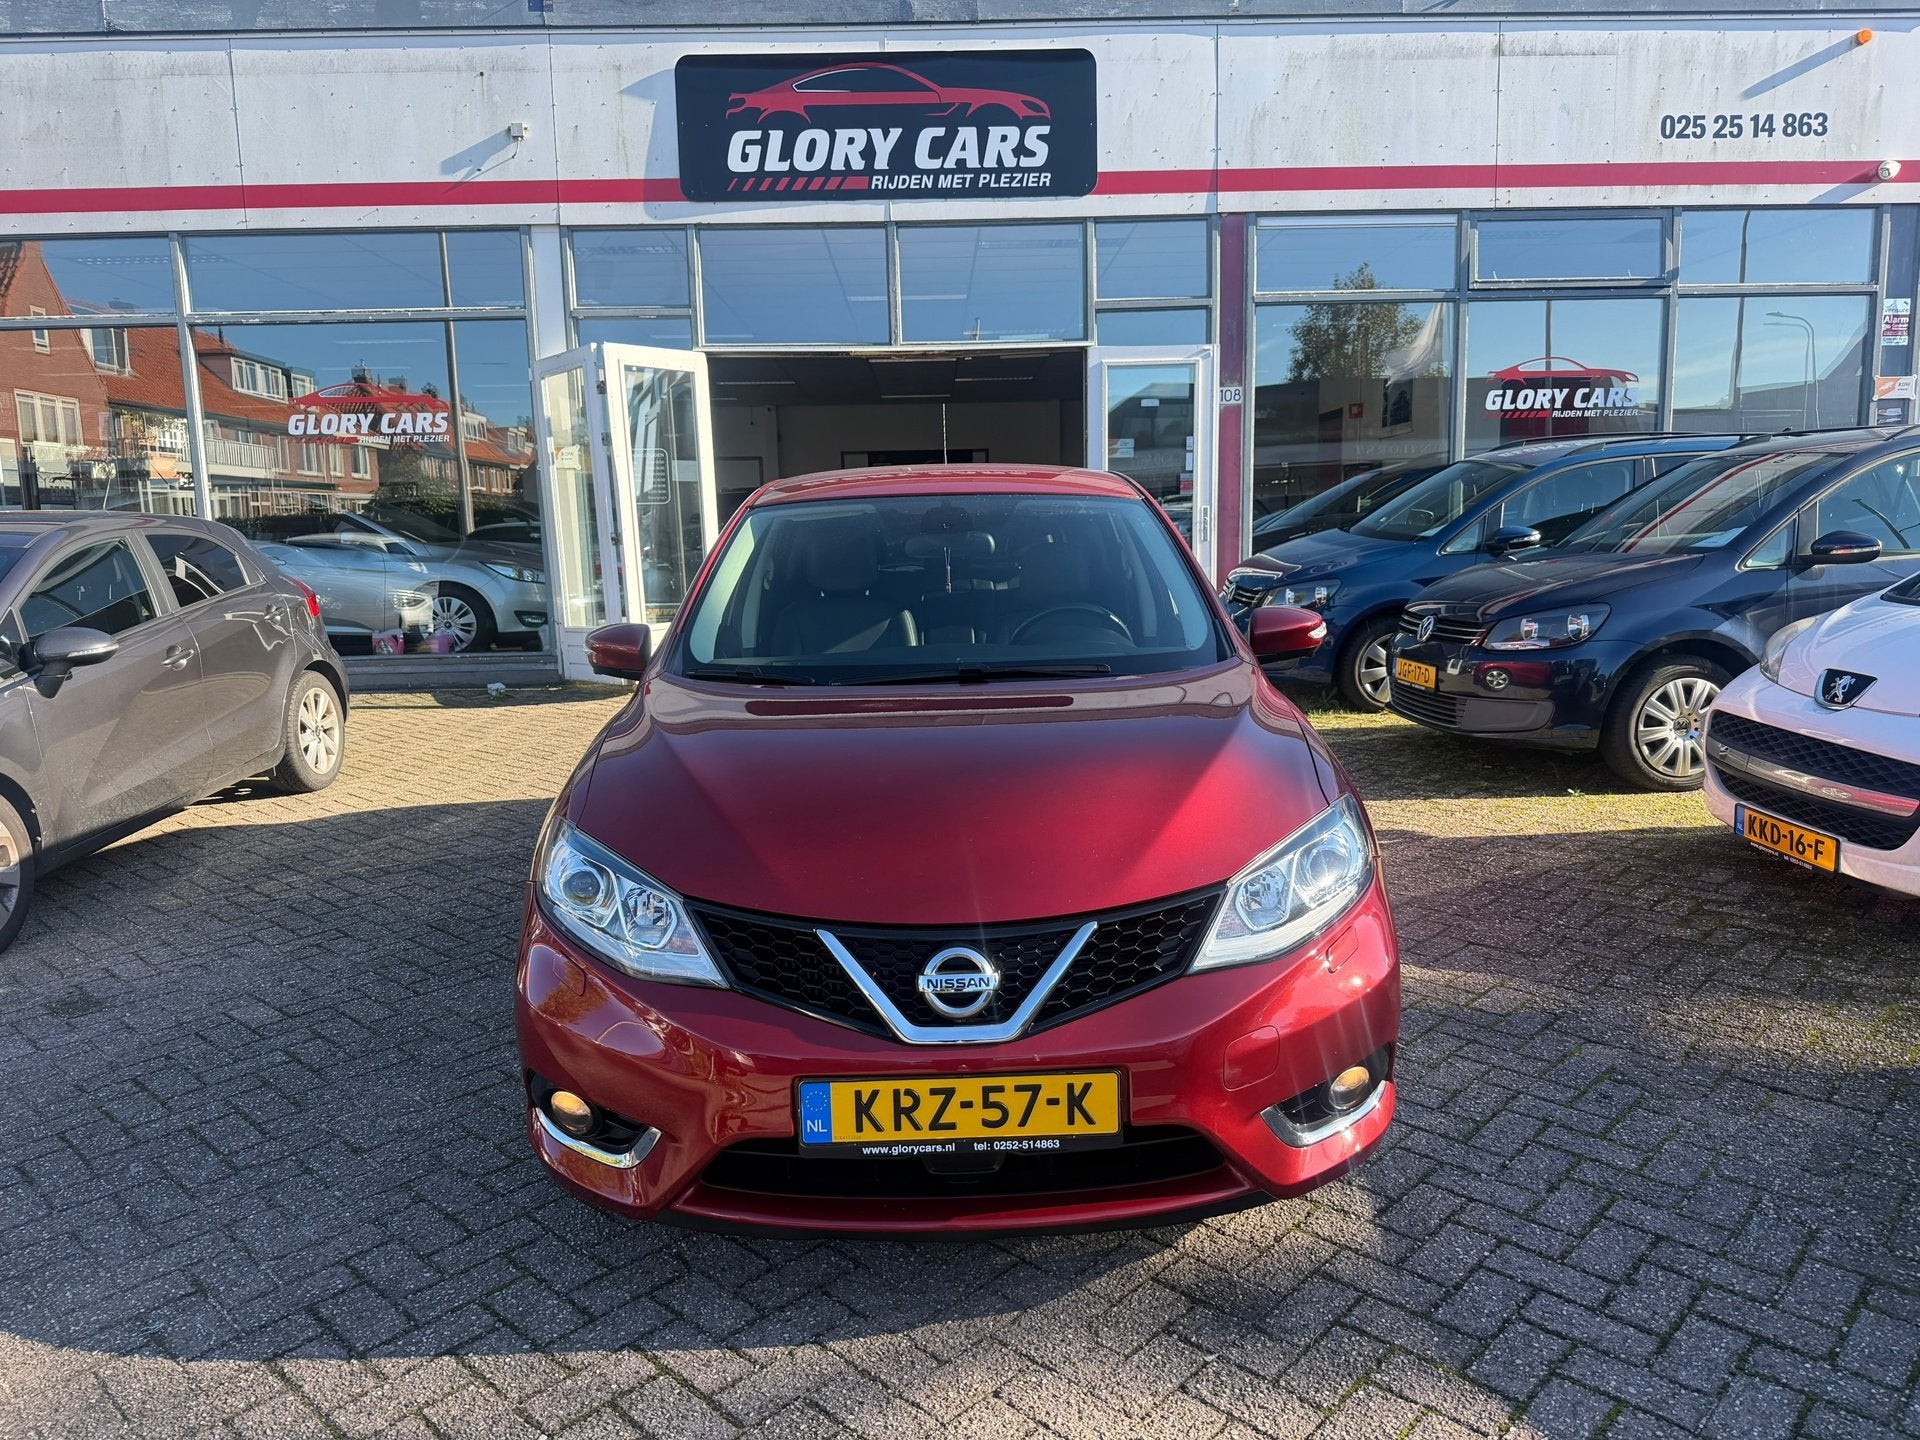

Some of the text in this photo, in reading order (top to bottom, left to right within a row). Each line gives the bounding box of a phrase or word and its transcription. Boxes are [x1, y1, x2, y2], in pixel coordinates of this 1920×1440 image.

[1660, 112, 1828, 139] 025 25 14 863
[727, 125, 1051, 173] GLORY CARS
[871, 173, 1052, 190] RIJDEN MET PLEZIER
[1883, 315, 1909, 324] Alarm
[1220, 388, 1241, 402] 108
[1485, 387, 1639, 411] GLORY CARS
[1603, 409, 1639, 417] PLEZIER
[287, 412, 449, 435] GLORY CARS
[393, 435, 412, 443] MET
[413, 435, 450, 443] PLEZIER
[1398, 661, 1429, 683] JGF-17-D
[1748, 813, 1826, 861] KKD-16-F
[926, 977, 990, 989] NISSAN
[853, 1081, 1097, 1134] KRZ-57-K
[806, 1119, 828, 1133] NL
[862, 1139, 1061, 1156] www.glorycars.nl tel: 0252-514863
